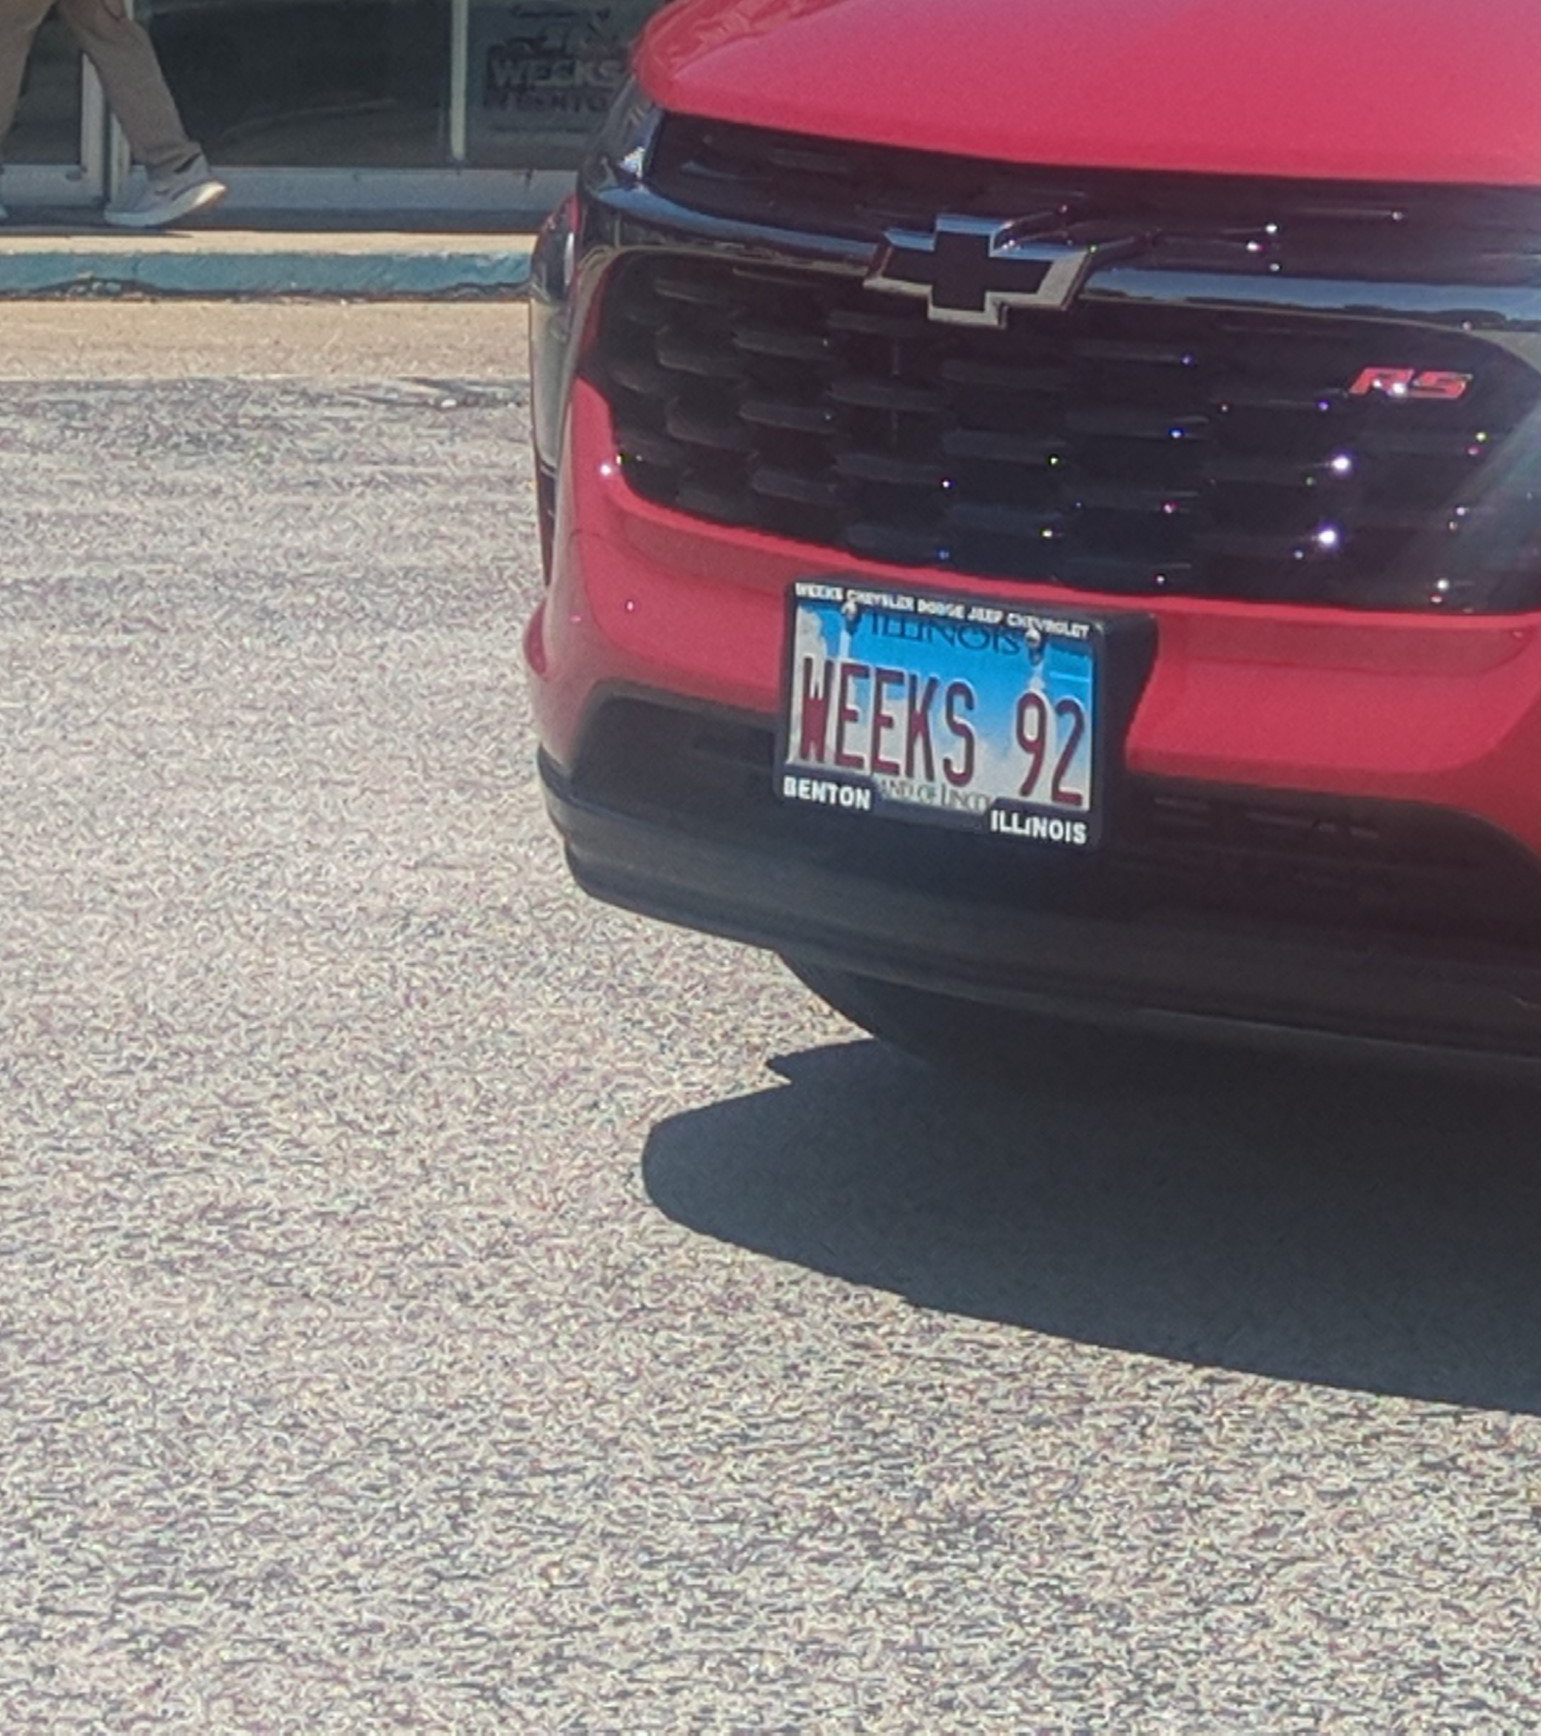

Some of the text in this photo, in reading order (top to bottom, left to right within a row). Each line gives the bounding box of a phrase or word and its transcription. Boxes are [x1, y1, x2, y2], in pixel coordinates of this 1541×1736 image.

[1348, 367, 1474, 400] RS
[795, 582, 1091, 639] WEEKS CHRYSLER DODGE JEEP CHEVROLET
[871, 611, 1022, 657] ILLINOIS
[799, 656, 1086, 808] WEEKS 92
[783, 775, 872, 811] BENTON
[990, 809, 1088, 846] ILLINOIS
